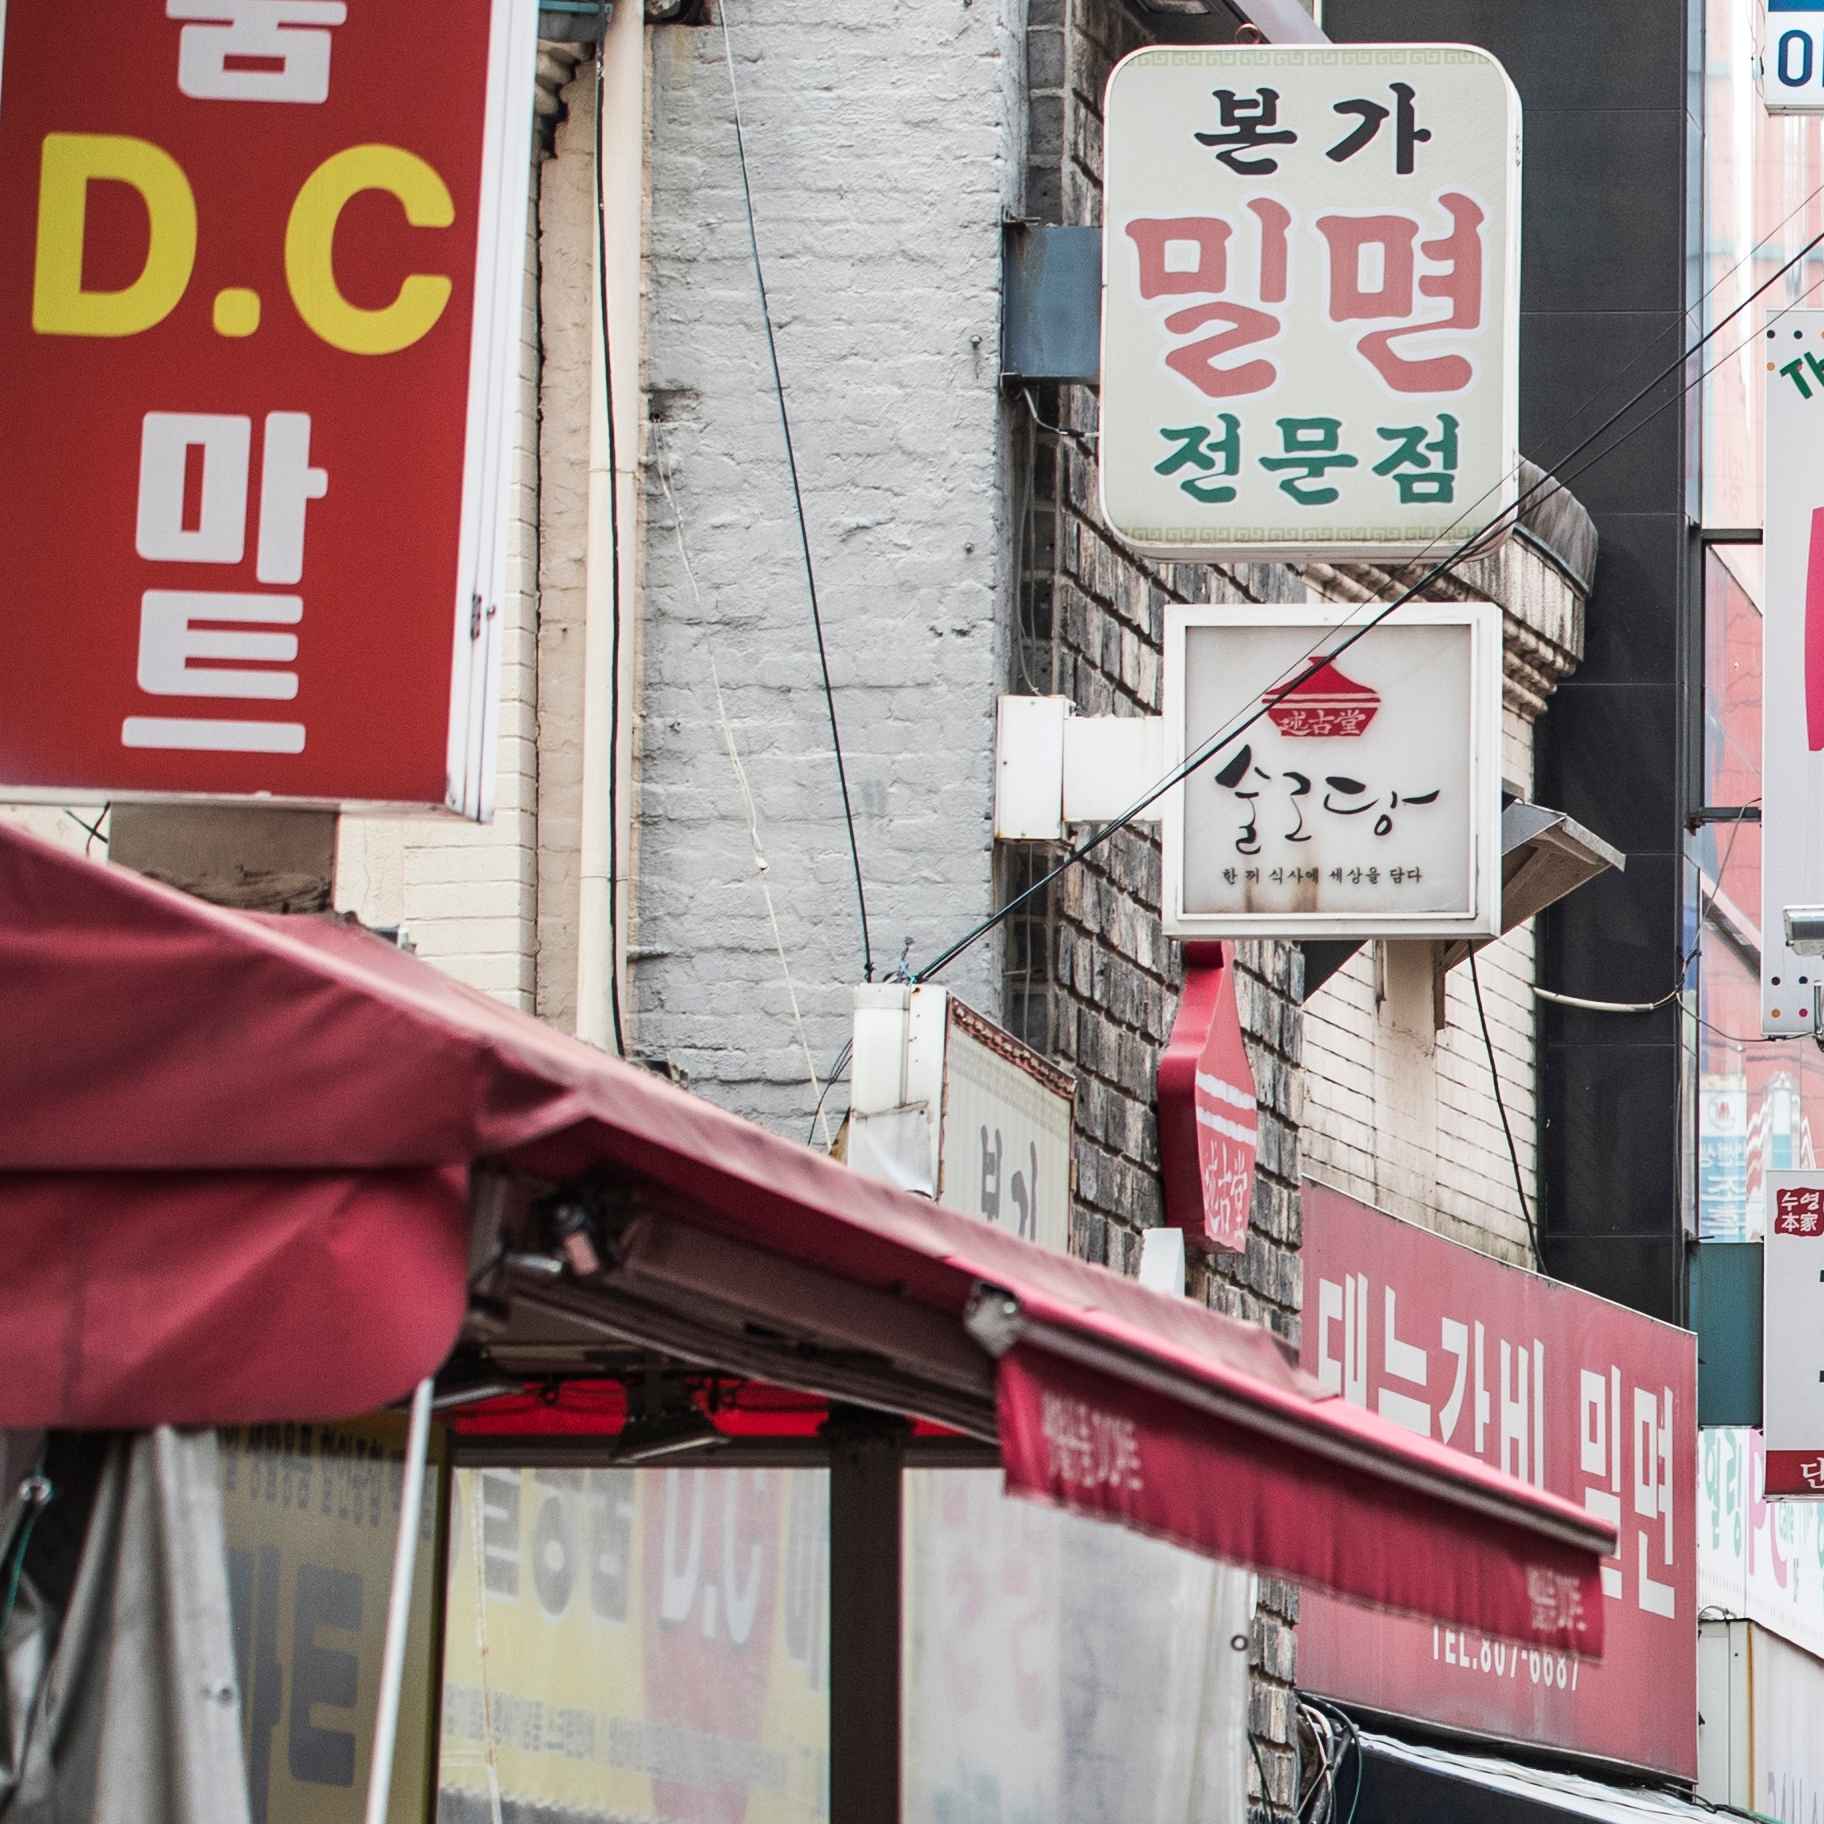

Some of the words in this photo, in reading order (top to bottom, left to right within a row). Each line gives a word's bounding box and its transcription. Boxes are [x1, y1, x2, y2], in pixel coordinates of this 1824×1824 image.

[1194, 83, 1433, 175] 본가
[32, 131, 455, 355] D.C
[1125, 192, 1485, 398] 밀면
[1153, 413, 1461, 505] 전문점
[121, 411, 329, 754] 마트
[1222, 867, 1237, 885] 한
[1245, 867, 1260, 884] 끼
[1269, 867, 1319, 885] 식사에
[1329, 867, 1380, 885] 세상을
[1390, 867, 1422, 884] 담다
